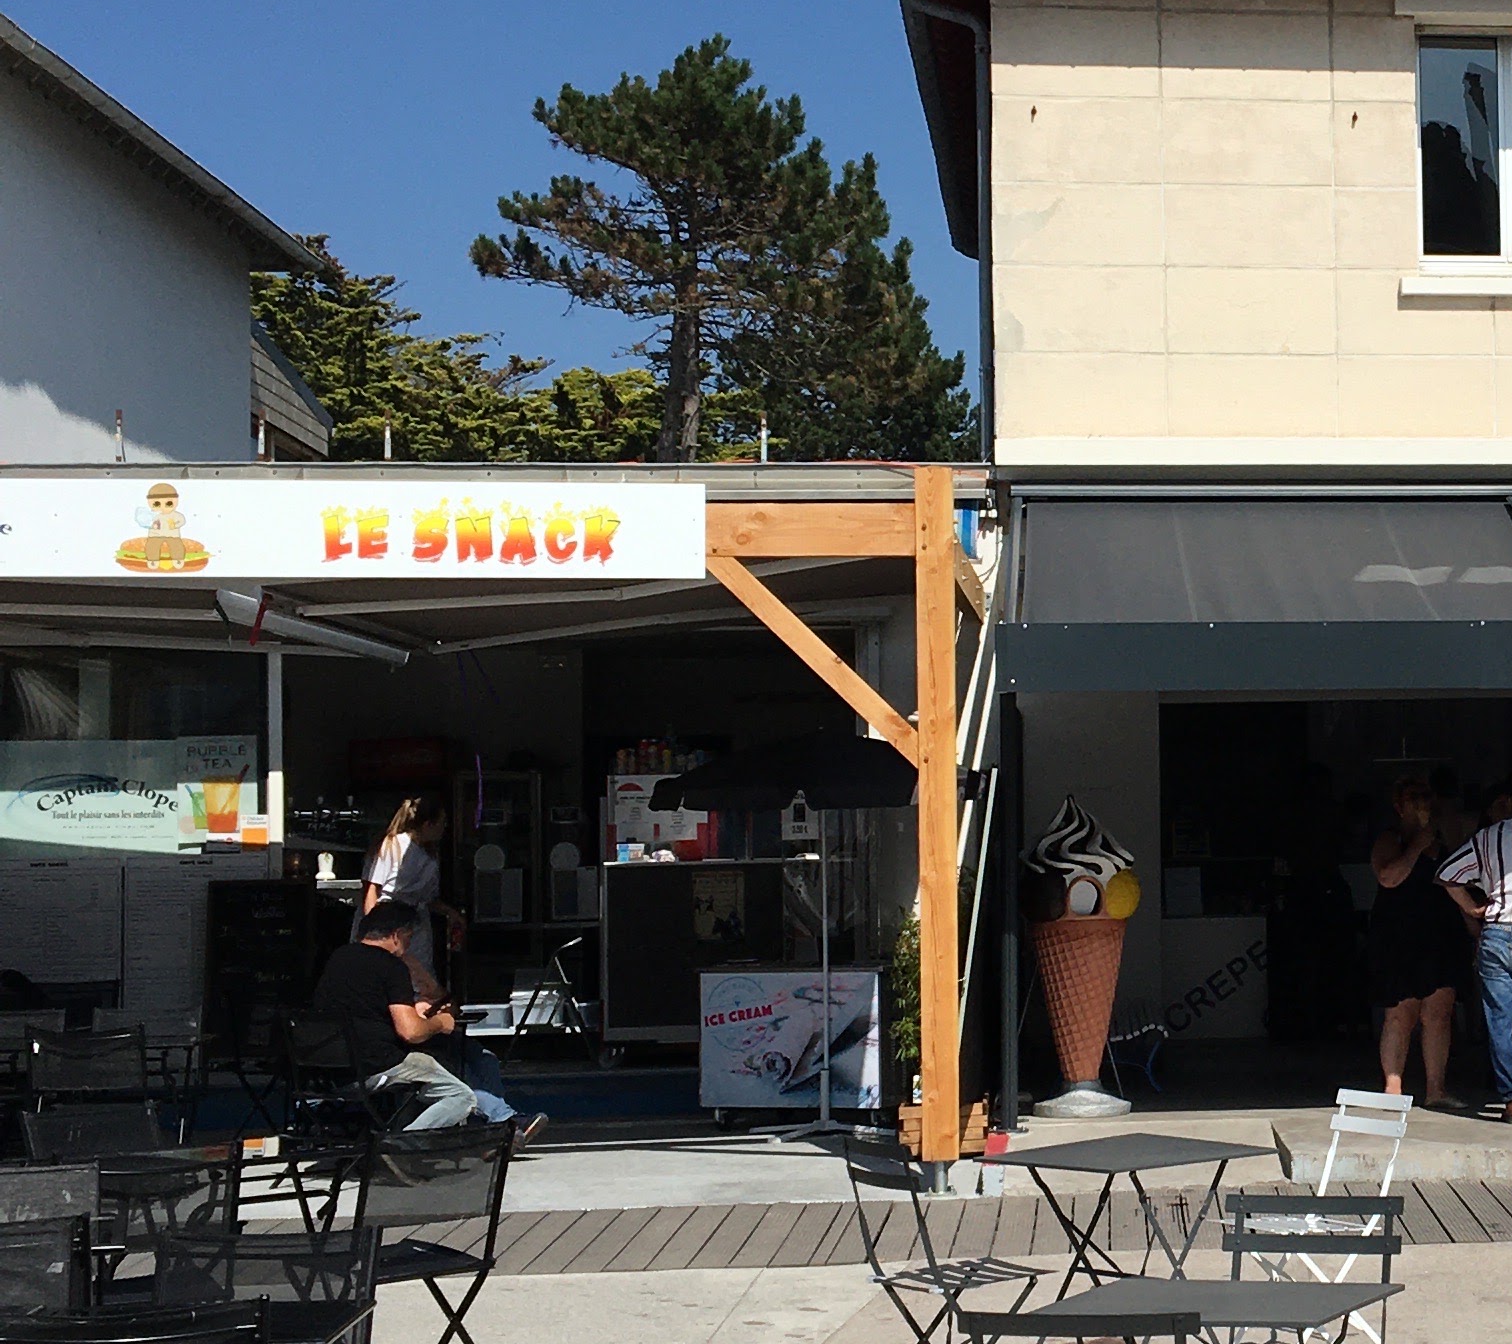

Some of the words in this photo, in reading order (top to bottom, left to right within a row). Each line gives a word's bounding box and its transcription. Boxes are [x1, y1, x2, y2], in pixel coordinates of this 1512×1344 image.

[321, 509, 389, 563] LE
[411, 509, 621, 566] SNACK
[202, 758, 232, 769] TEA
[121, 778, 179, 813] Clope
[52, 810, 69, 819] Tout
[70, 809, 77, 819] le
[78, 809, 102, 821] plaisir
[121, 809, 131, 819] les
[704, 1012, 726, 1027] ICE
[728, 1004, 773, 1023] CREAM
